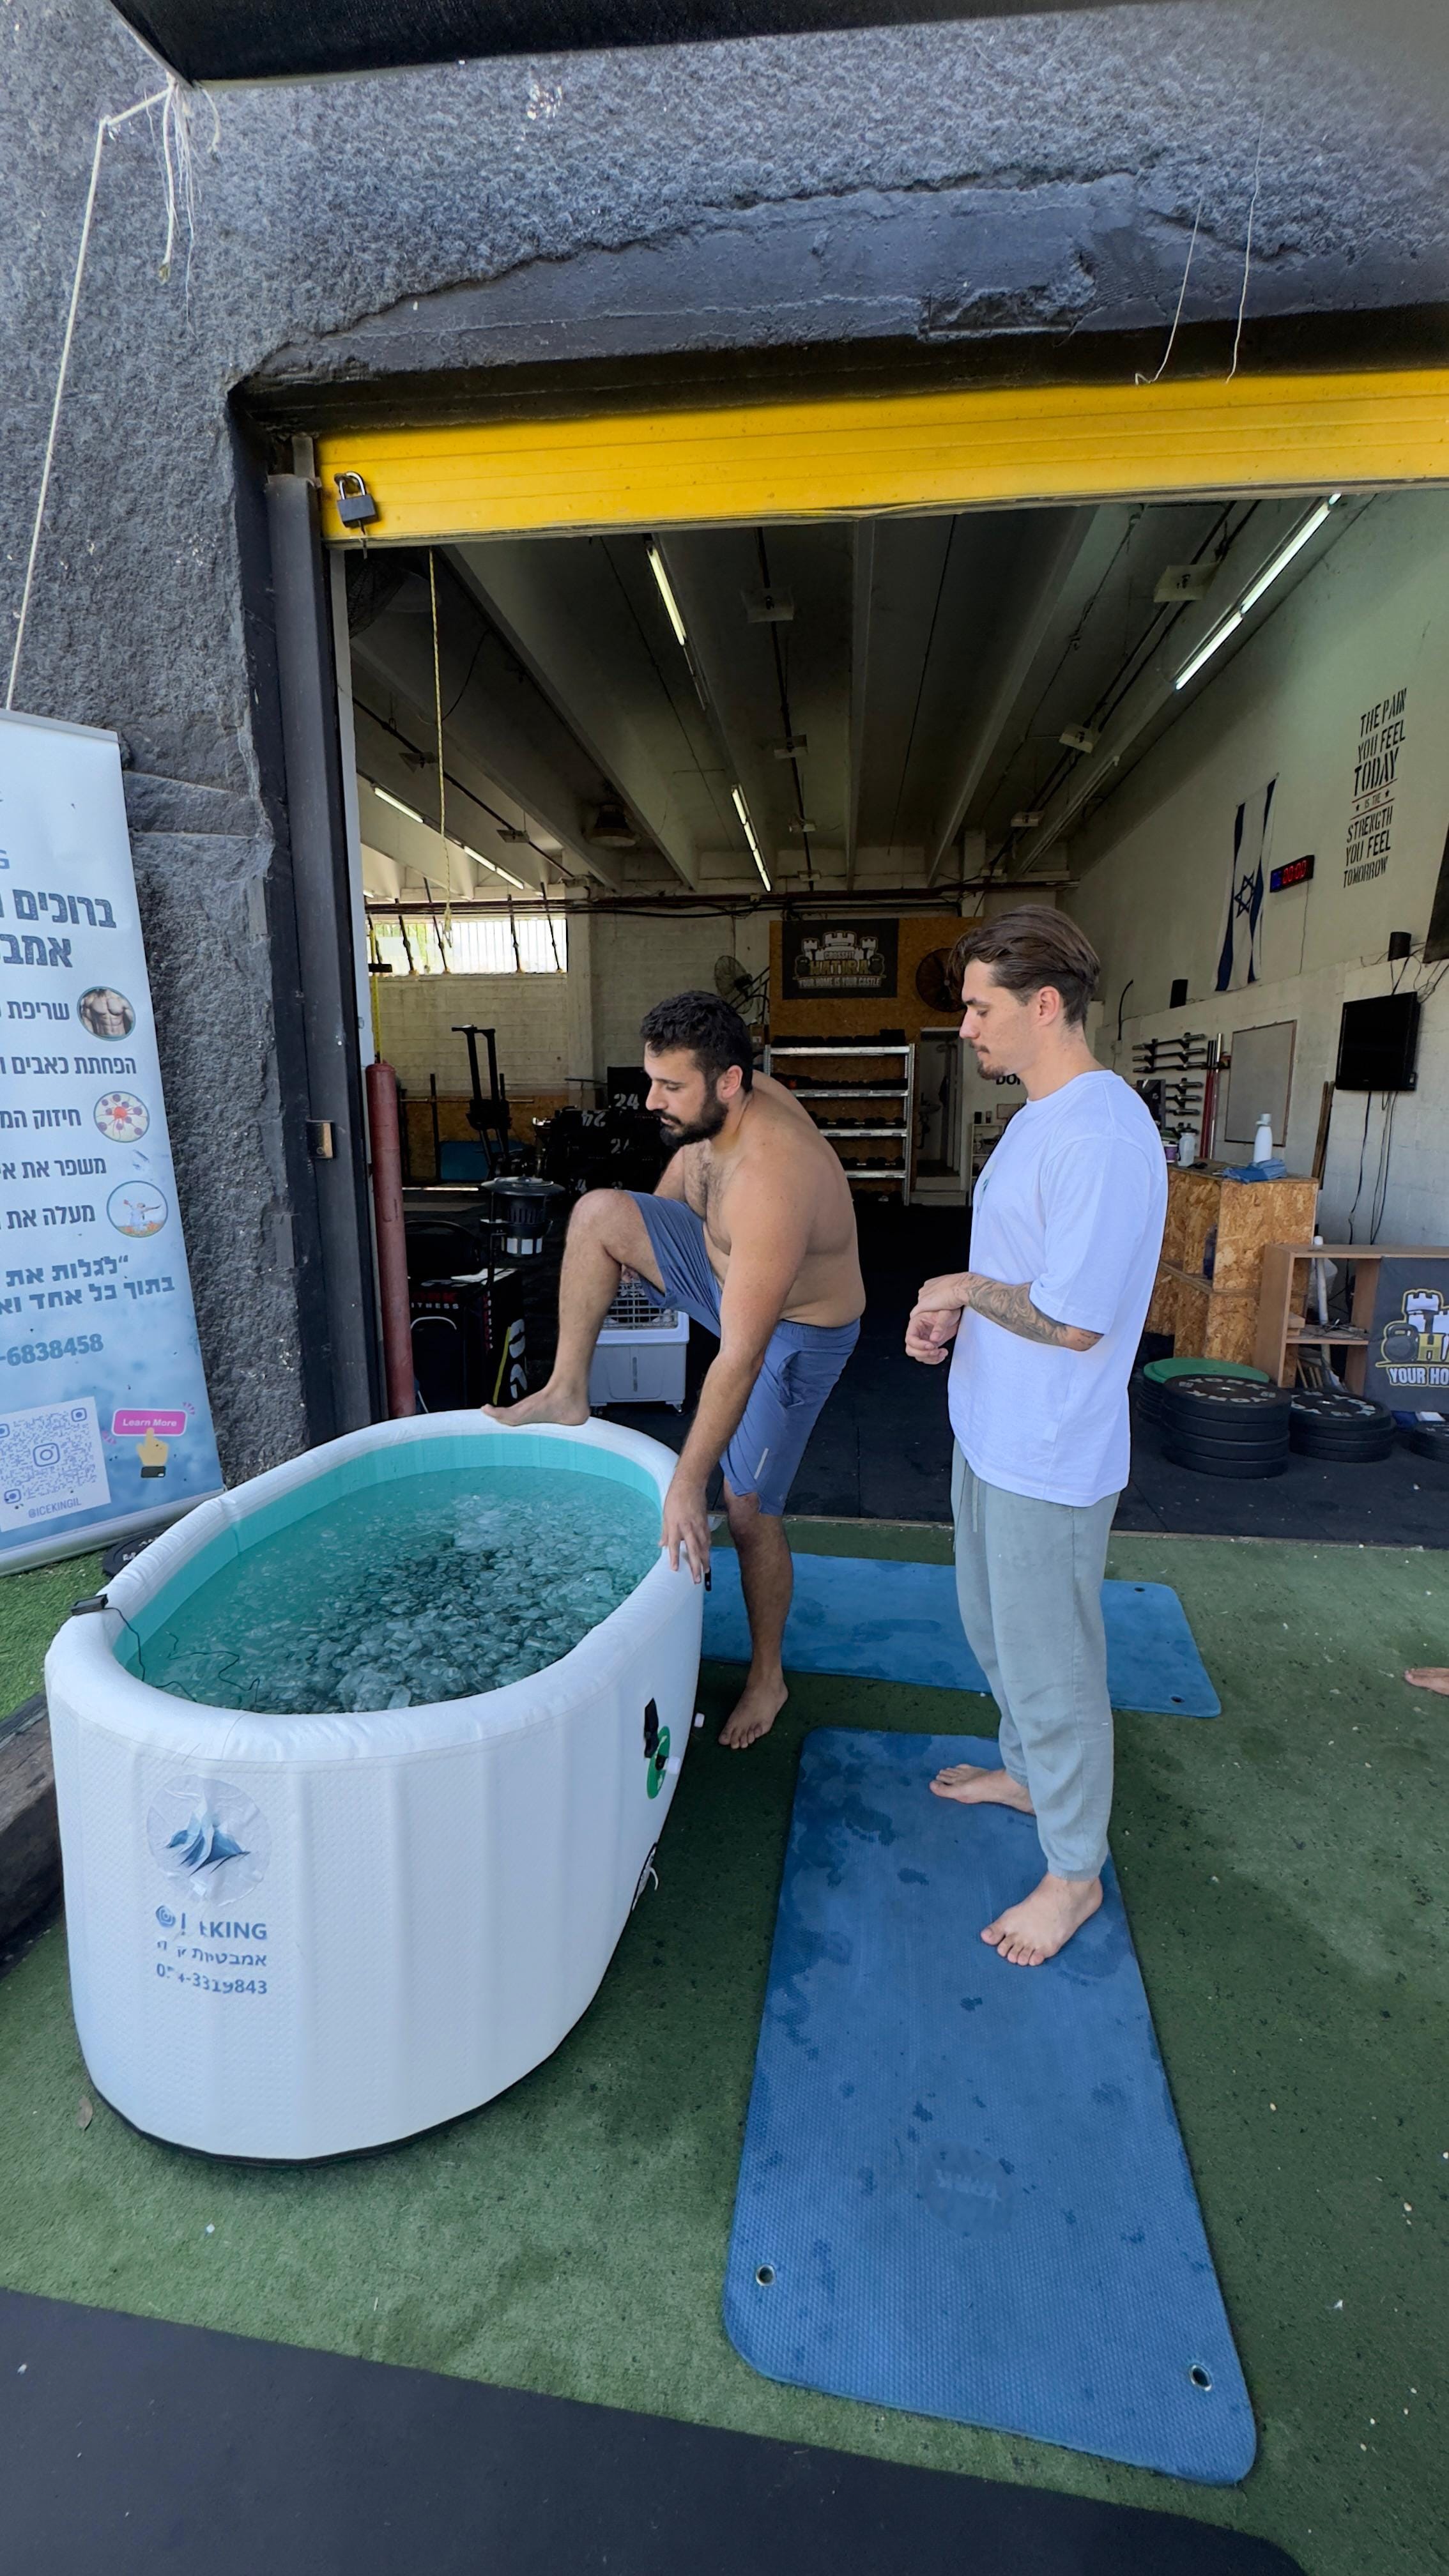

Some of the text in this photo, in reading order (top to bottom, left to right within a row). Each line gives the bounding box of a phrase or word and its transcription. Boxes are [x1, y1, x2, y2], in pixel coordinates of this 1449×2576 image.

[1361, 687, 1407, 738] THE PAIN
[1358, 719, 1406, 763] YOU FEEL
[1354, 746, 1399, 796] TODAY
[1347, 806, 1393, 843] STRENGTH
[1346, 829, 1390, 866] YOU FEEL
[1343, 855, 1388, 889] TOMORROW
[12, 889, 117, 928] ברוכים
[0, 933, 73, 968] אמב
[809, 959, 870, 976] HATIRA
[859, 977, 880, 986] CASTLE
[7, 1001, 70, 1020] שריפת
[12, 1057, 70, 1074] כאבים
[74, 1057, 137, 1075] הפחתת
[0, 1108, 82, 1130] חיזוק המ
[21, 1161, 50, 1179] את
[54, 1158, 107, 1176] משפר
[6, 1209, 37, 1230] את
[42, 1204, 95, 1226] מעלה
[6, 1267, 44, 1287] את
[88, 1284, 117, 1302] כל
[123, 1276, 175, 1300] בתוך
[29, 1289, 82, 1310] אחד
[0, 1334, 103, 1367] -6838458
[1389, 1367, 1449, 1386] YOUR HO
[123, 1418, 151, 1427] Learn
[28, 1497, 82, 1519] @ICEKINGIL
